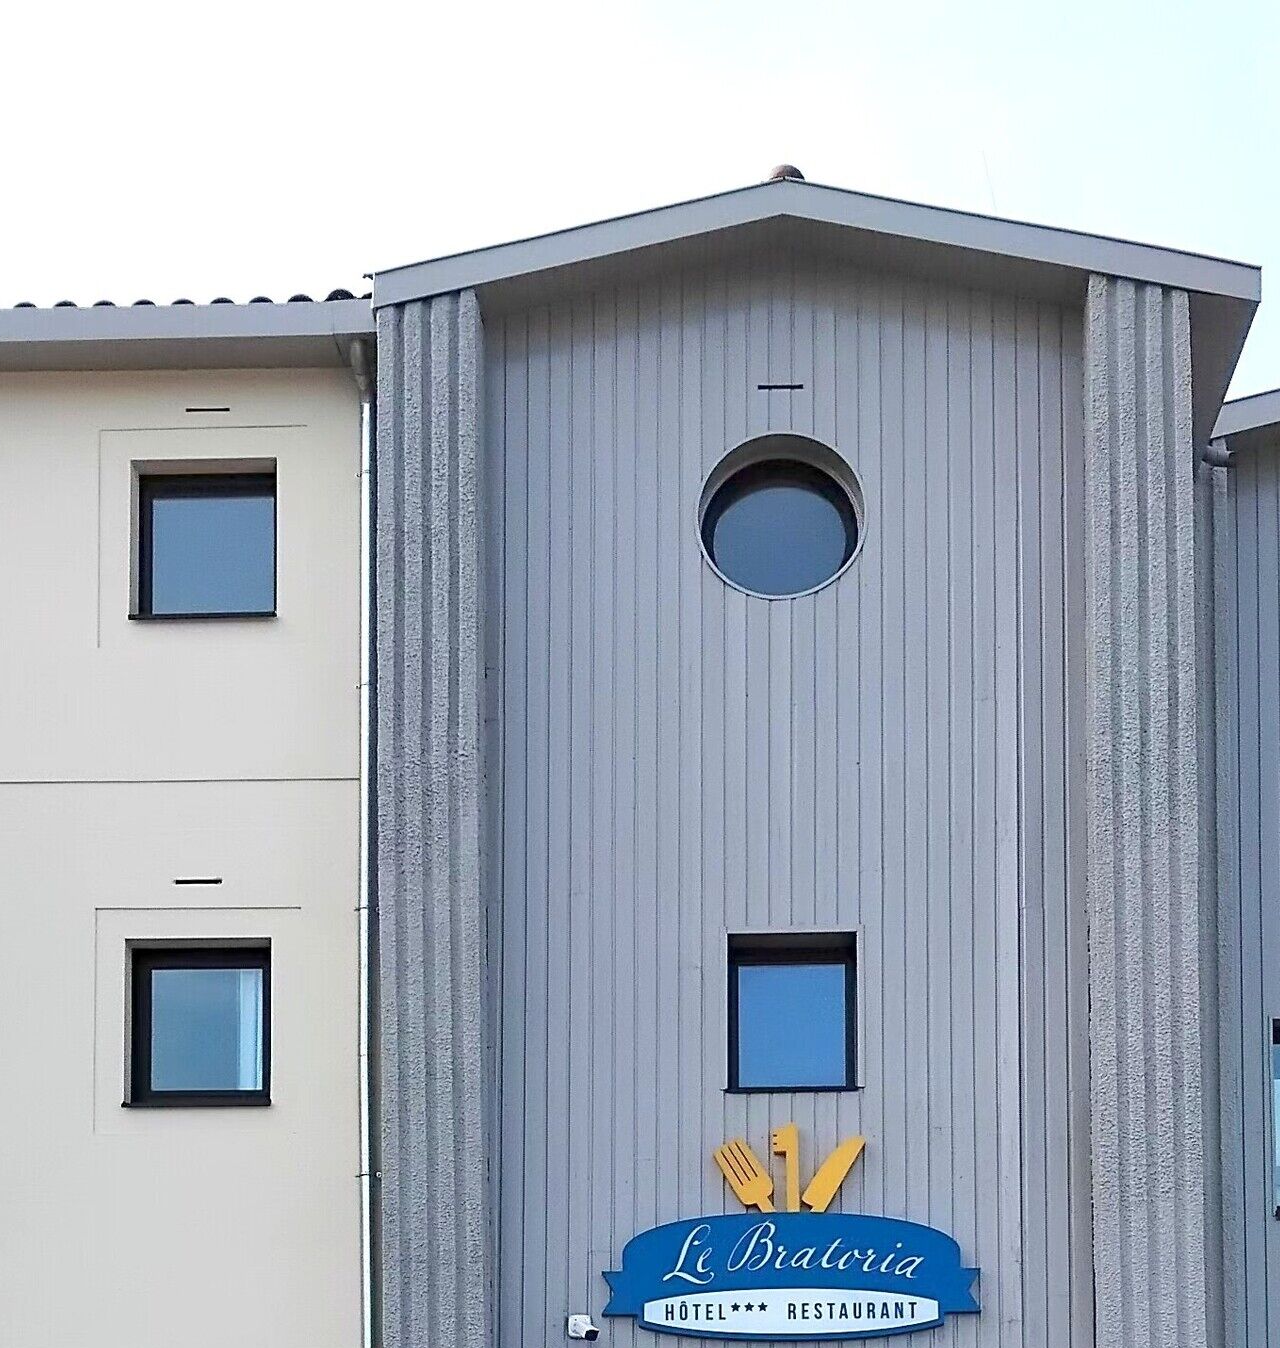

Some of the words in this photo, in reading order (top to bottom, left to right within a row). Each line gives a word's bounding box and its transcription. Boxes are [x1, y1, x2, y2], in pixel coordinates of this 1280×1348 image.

[663, 1223, 715, 1284] Le
[727, 1220, 925, 1279] Bratoria
[787, 1300, 919, 1320] RESTAURANT
